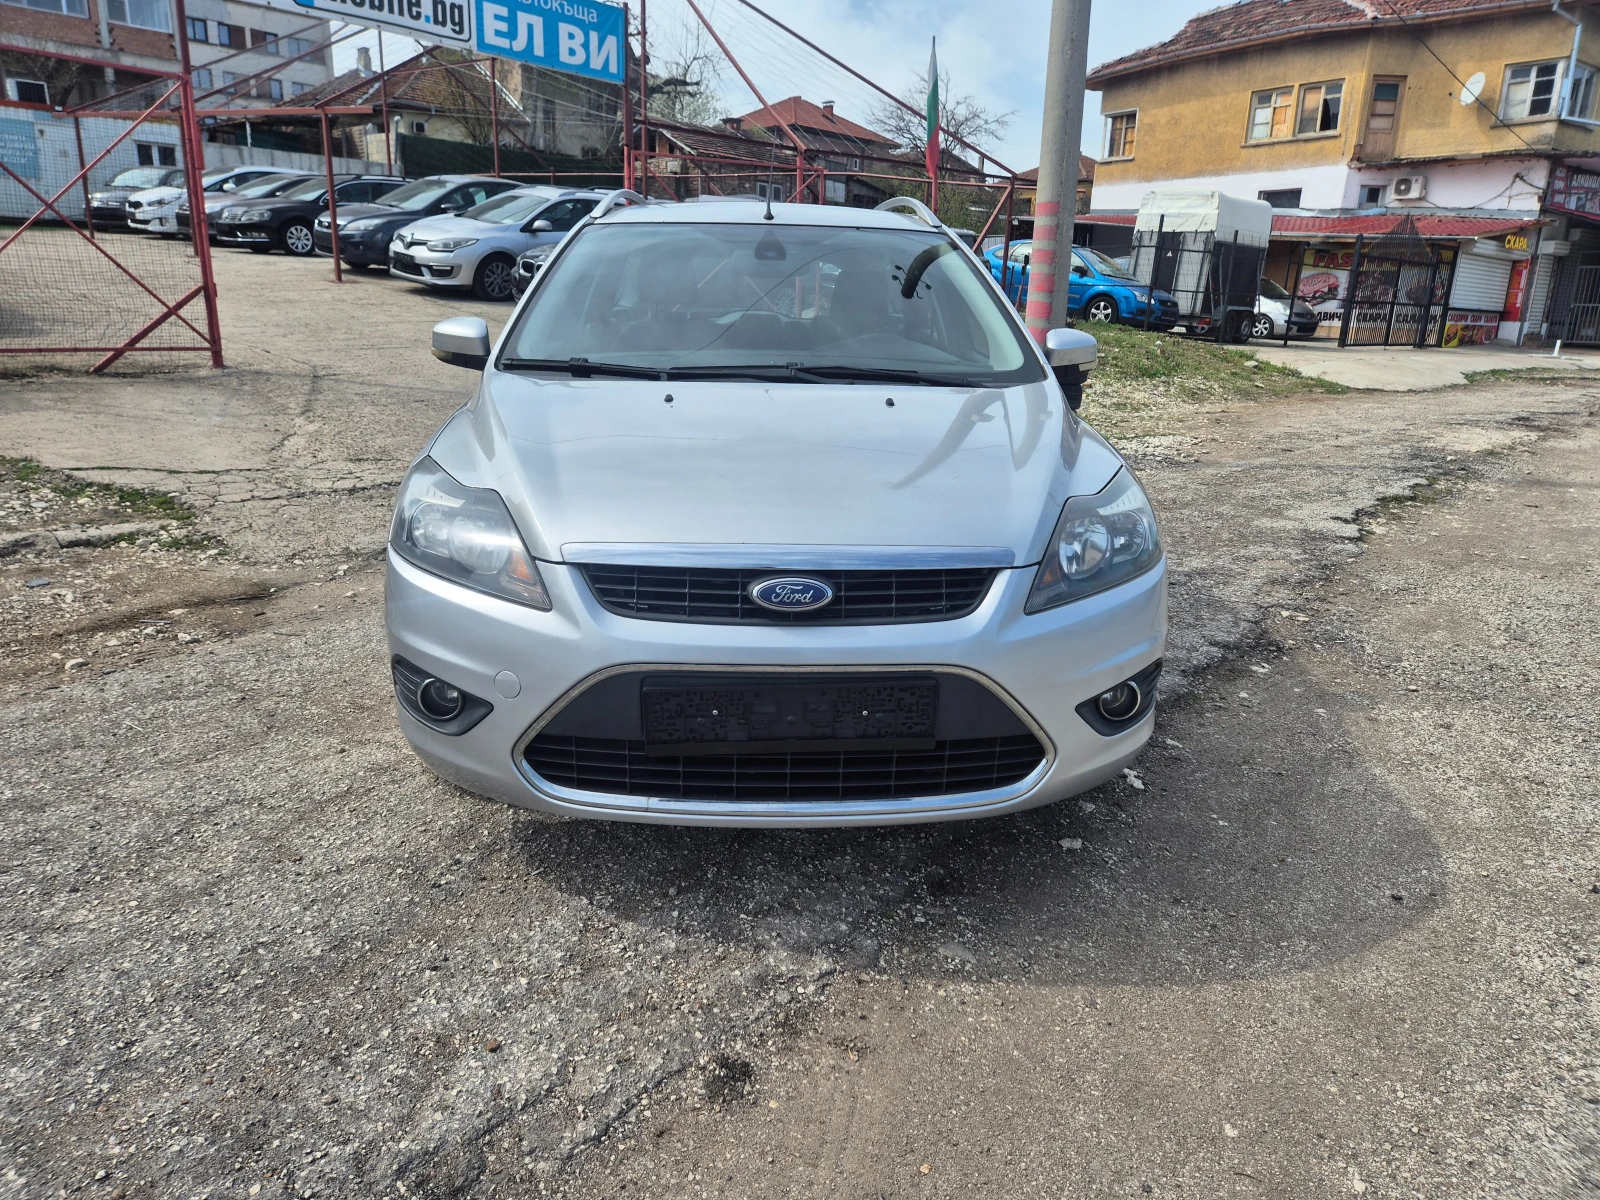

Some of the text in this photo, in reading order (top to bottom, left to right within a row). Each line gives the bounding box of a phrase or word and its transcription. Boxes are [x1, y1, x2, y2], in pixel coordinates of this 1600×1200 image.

[482, 2, 618, 74] ЕЛ ВИ
[1505, 235, 1527, 251] СКАРА
[1313, 252, 1363, 269] FAS
[771, 584, 814, 602] Ford
